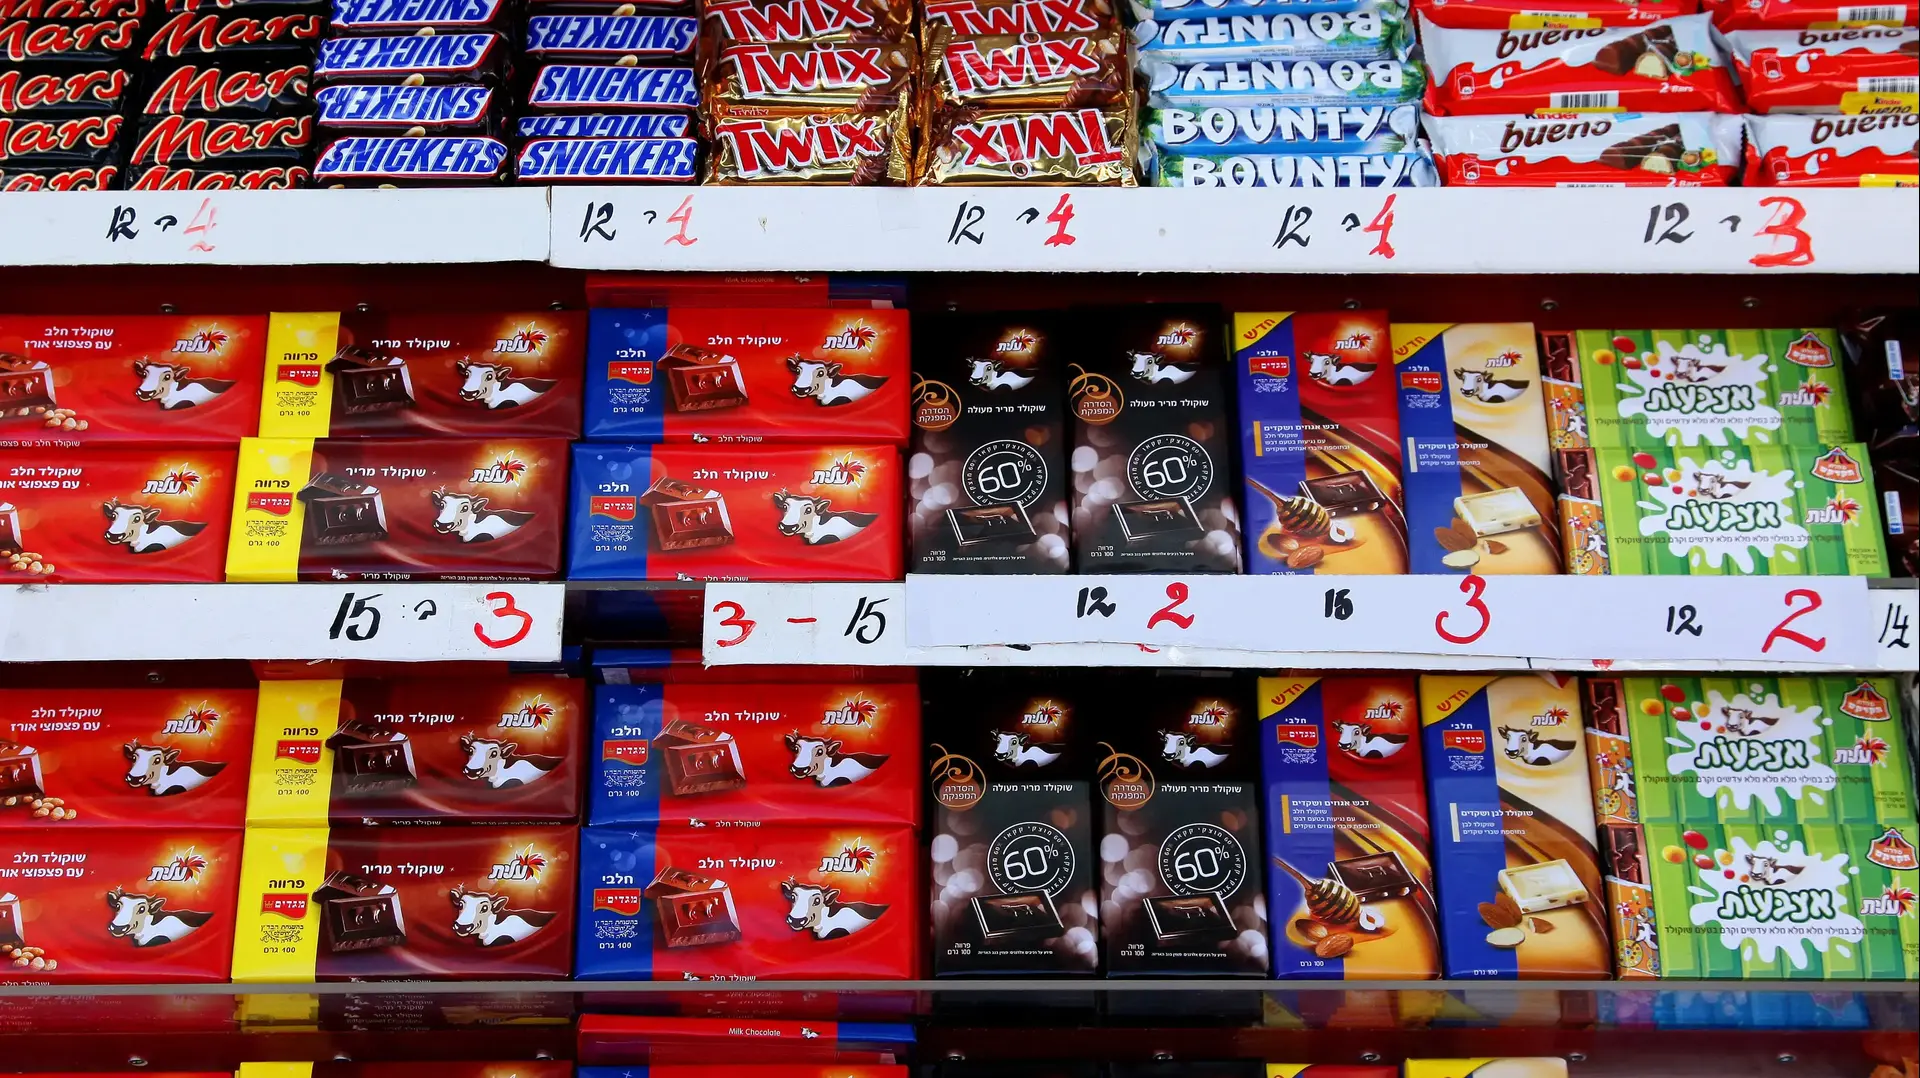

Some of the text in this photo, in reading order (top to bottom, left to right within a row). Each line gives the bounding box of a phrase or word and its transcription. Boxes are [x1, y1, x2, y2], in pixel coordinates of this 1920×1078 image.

[706, 0, 874, 41] Twix
[1628, 8, 1637, 19] 2
[141, 11, 319, 60] Mars
[526, 16, 697, 50] SNICKERS
[1164, 12, 1381, 44] BOUNTY
[1799, 29, 1902, 46] bueno
[1497, 28, 1606, 59] bueno
[722, 43, 890, 98] Twix
[943, 33, 1100, 94] Twix
[1183, 60, 1402, 91] BOUNTY
[1660, 83, 1668, 93] 2
[1163, 106, 1384, 144] BOUNTY
[1811, 113, 1919, 144] bueno
[130, 115, 312, 165] Mars
[716, 115, 883, 177] Twix
[1500, 120, 1612, 153] bueno
[326, 138, 506, 173] SNICKERS
[1183, 154, 1407, 187] BOUNTY
[106, 206, 139, 242] 12
[580, 202, 616, 242] 12
[664, 194, 698, 246] 4
[948, 201, 985, 245] 12
[1043, 193, 1076, 247] 4
[1272, 205, 1313, 249] 12
[1363, 193, 1397, 259] 4
[1644, 202, 1694, 244] 12
[45, 327, 114, 337] שוקולד חלב
[1243, 318, 1276, 340] חדש
[24, 340, 50, 349] אורז
[96, 340, 112, 349] עם
[172, 335, 210, 353] עלית
[371, 337, 450, 349] שוקולד מריר
[492, 335, 530, 353] עלית
[708, 335, 782, 347] שוקולד חלב
[822, 333, 859, 349] עלית
[1394, 335, 1426, 356] חדש
[283, 352, 318, 362] פרווה
[616, 348, 646, 358] חלבי
[1017, 404, 1046, 413] שוקולד
[1645, 382, 1754, 414] אצבעות
[921, 407, 949, 415] הסדרה
[968, 406, 993, 414] מעולה
[735, 435, 763, 443] שוקולד
[978, 459, 1032, 494] 60%
[1077, 581, 1195, 629] 12 2
[1435, 574, 1491, 644] 3
[329, 592, 381, 641] 15
[474, 592, 533, 648] 3
[713, 601, 756, 647] 3
[844, 596, 889, 645] 15
[1667, 588, 1826, 653] 12 2
[1271, 683, 1305, 706] חדש
[31, 708, 102, 719] שוקולד חלב
[704, 711, 780, 722] שוקולד חלב
[820, 707, 859, 724] עלית
[10, 722, 37, 732] אורז
[83, 722, 100, 731] עם
[162, 718, 201, 734] עלית
[611, 726, 641, 736] חלבי
[1694, 736, 1809, 771] אצבעות
[1113, 784, 1143, 792] הסדרה
[1161, 784, 1241, 794] שוקולד מריר מעולה
[734, 820, 761, 828] שוקולד
[362, 863, 444, 876] שוקולד מריר
[488, 860, 528, 880] עלית
[1174, 845, 1230, 883] 60%
[269, 879, 305, 889] פרווה
[1718, 885, 1836, 923] אצבעות
[729, 1027, 781, 1037] Milk Chocolate
